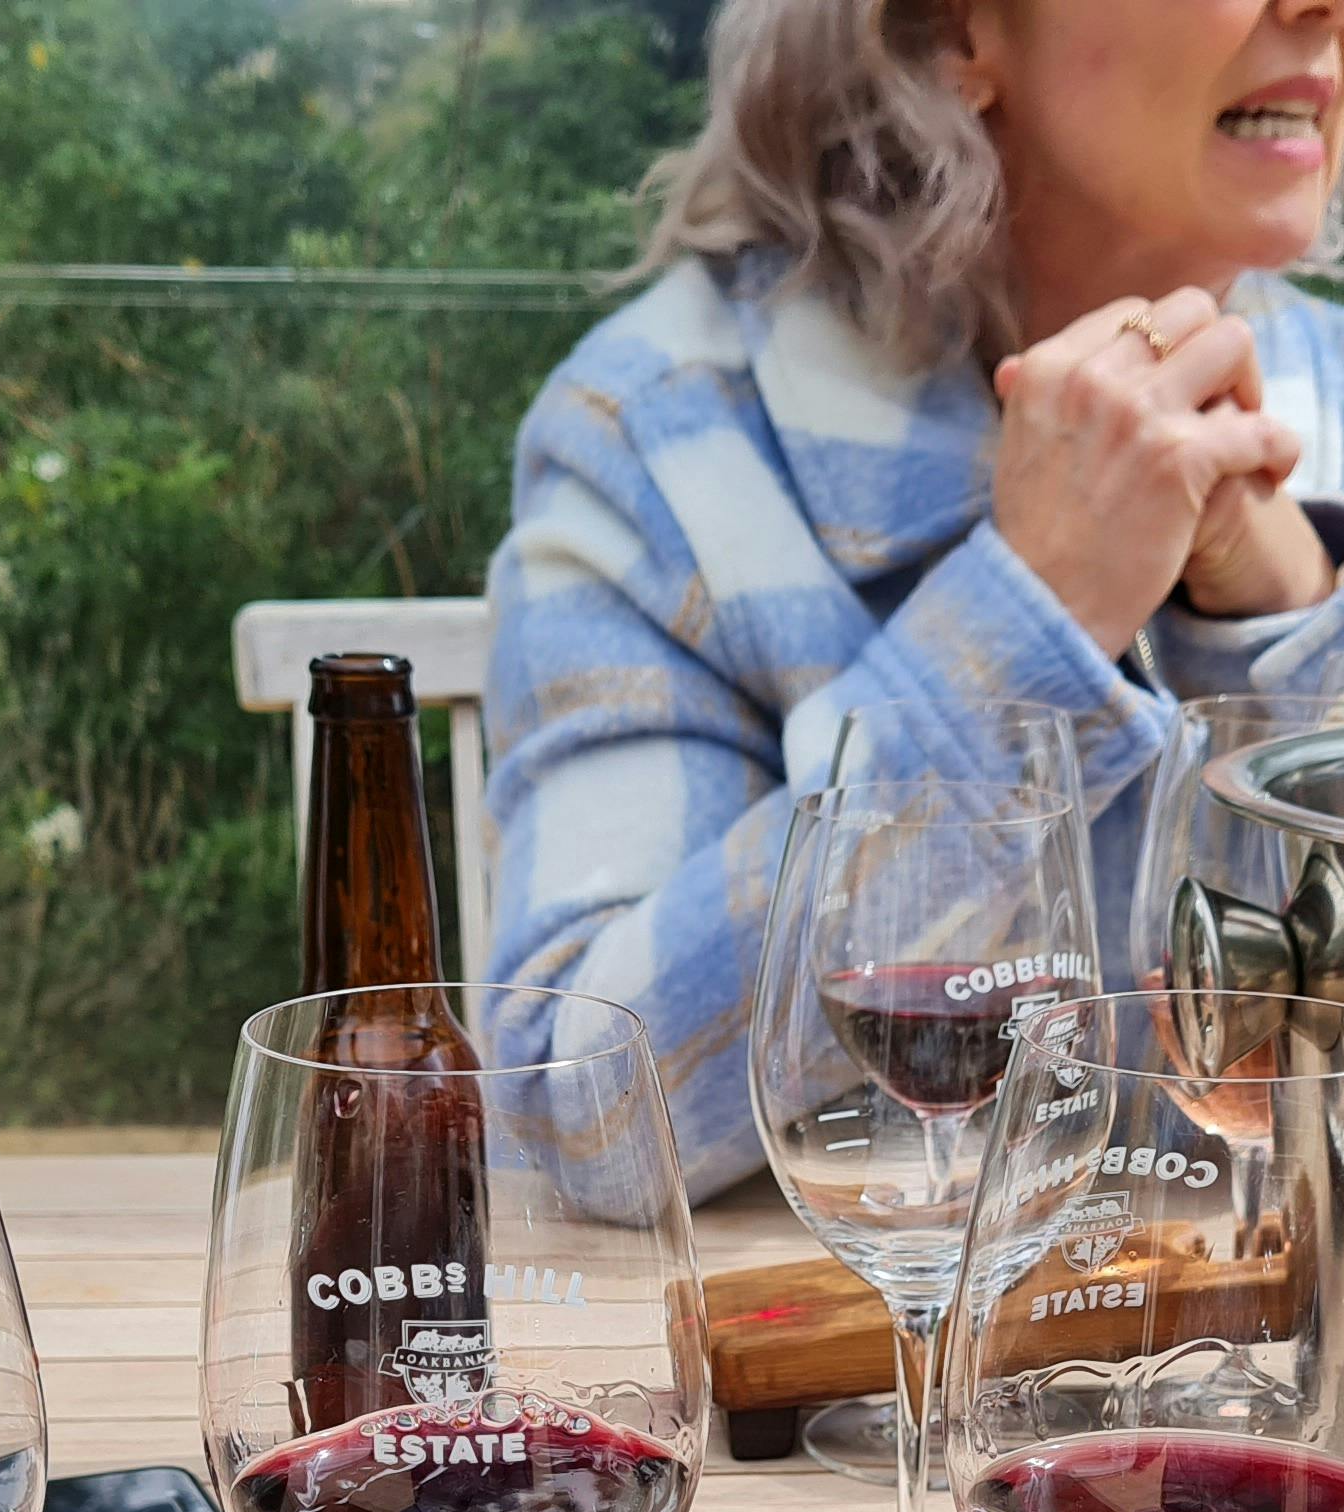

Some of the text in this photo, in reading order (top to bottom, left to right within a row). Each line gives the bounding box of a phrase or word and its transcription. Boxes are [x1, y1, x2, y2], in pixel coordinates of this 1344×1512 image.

[1053, 952, 1093, 982] HILL
[1035, 1089, 1098, 1123] ESTATE
[483, 1264, 587, 1309] HILL
[406, 1352, 485, 1368] OAKBANK
[373, 1432, 526, 1466] ESTATE
